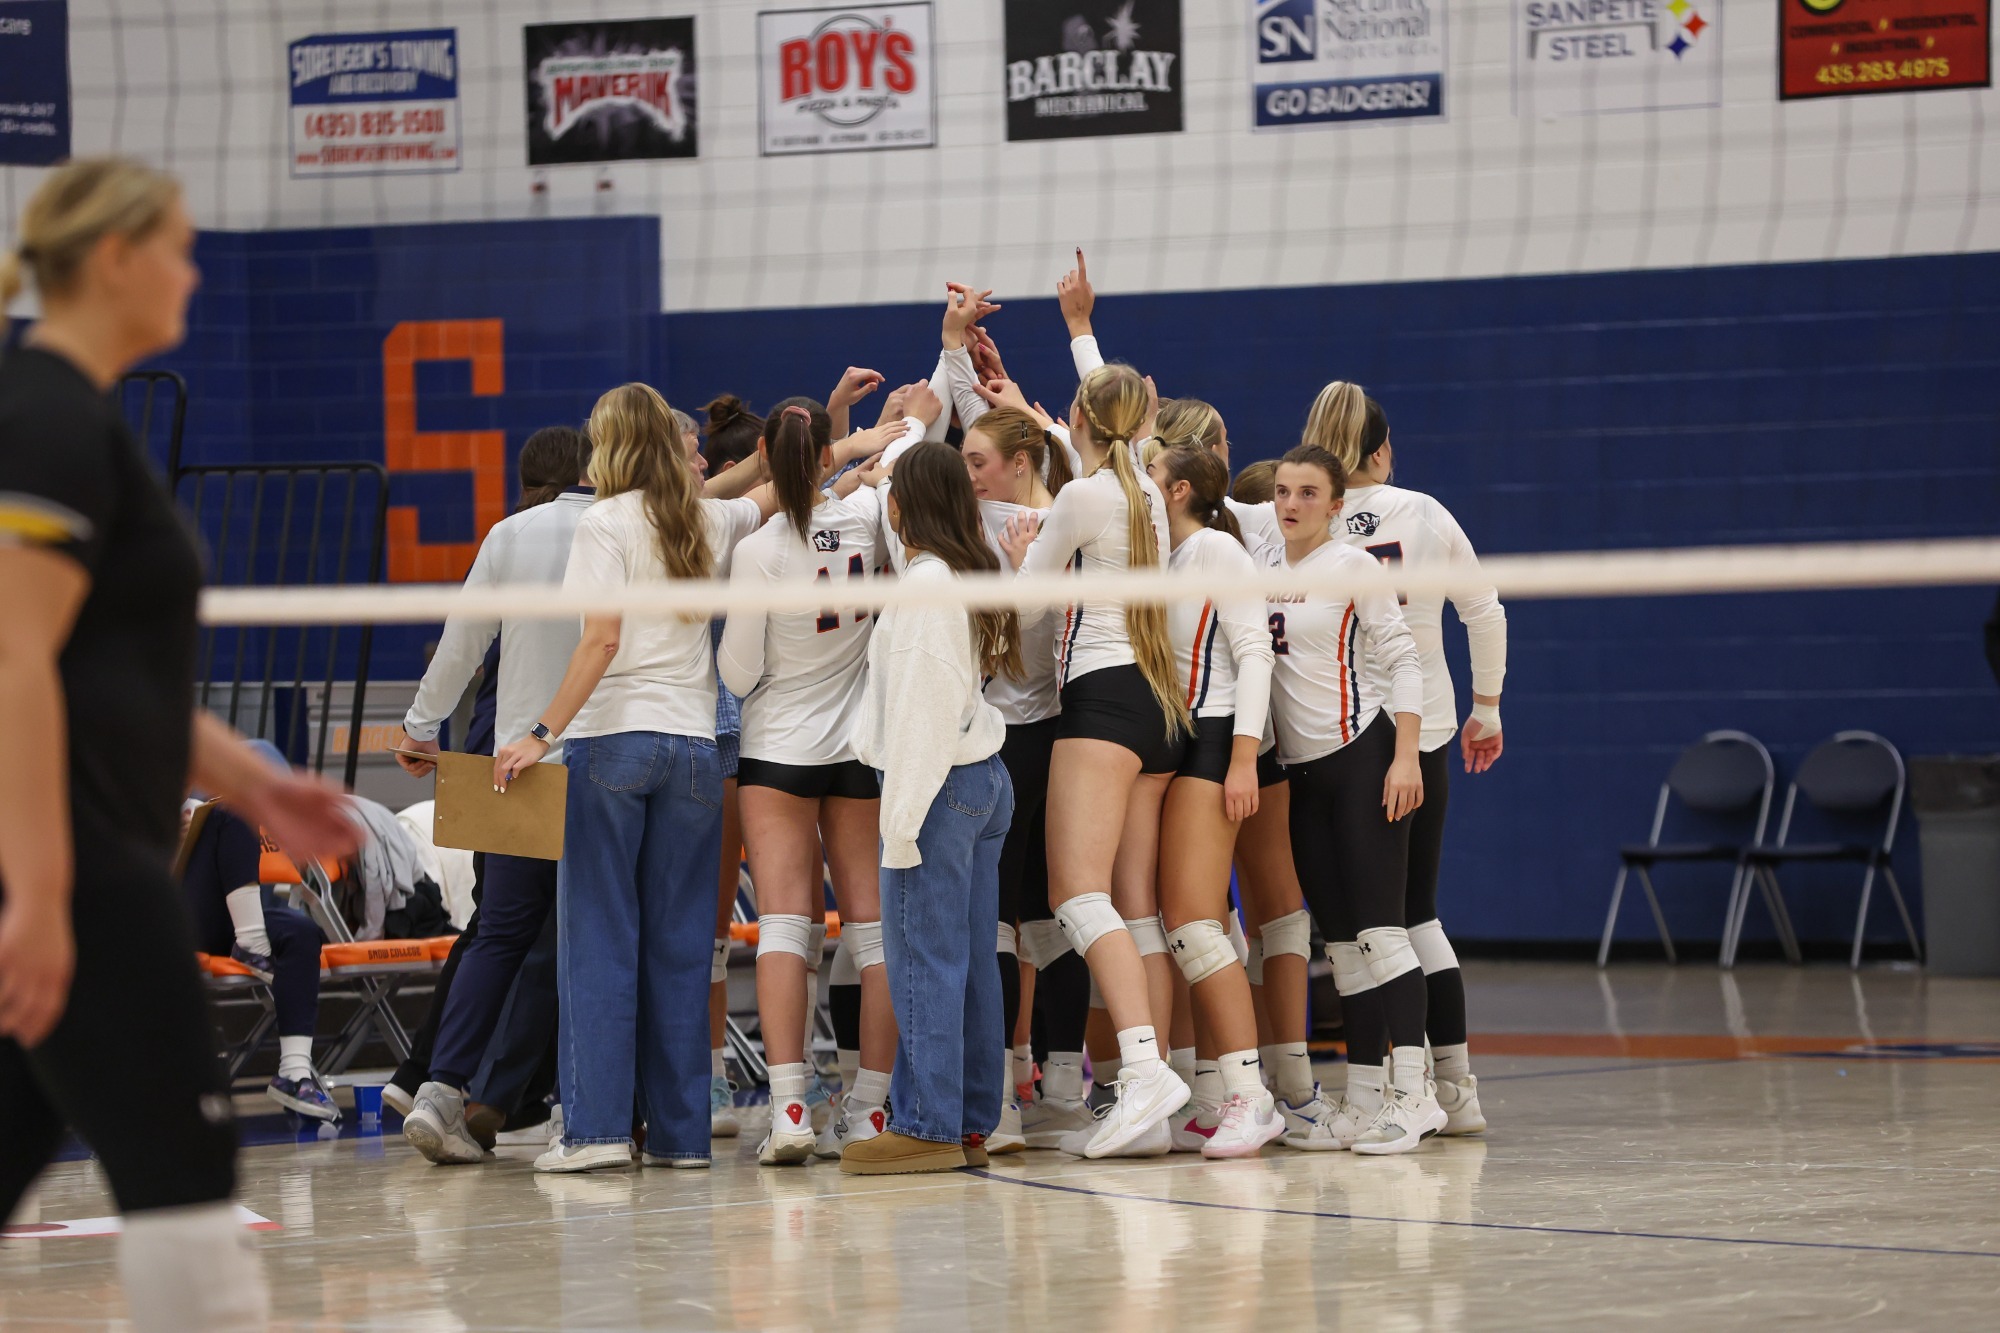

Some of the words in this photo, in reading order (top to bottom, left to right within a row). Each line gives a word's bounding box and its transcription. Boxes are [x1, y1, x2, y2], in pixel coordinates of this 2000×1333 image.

[1322, 8, 1430, 43] National
[780, 16, 916, 104] ROY'S
[1549, 33, 1635, 62] STEEL
[1008, 49, 1177, 103] BARCLAY
[1266, 88, 1307, 118] GO
[1308, 80, 1432, 115] BADGERS!
